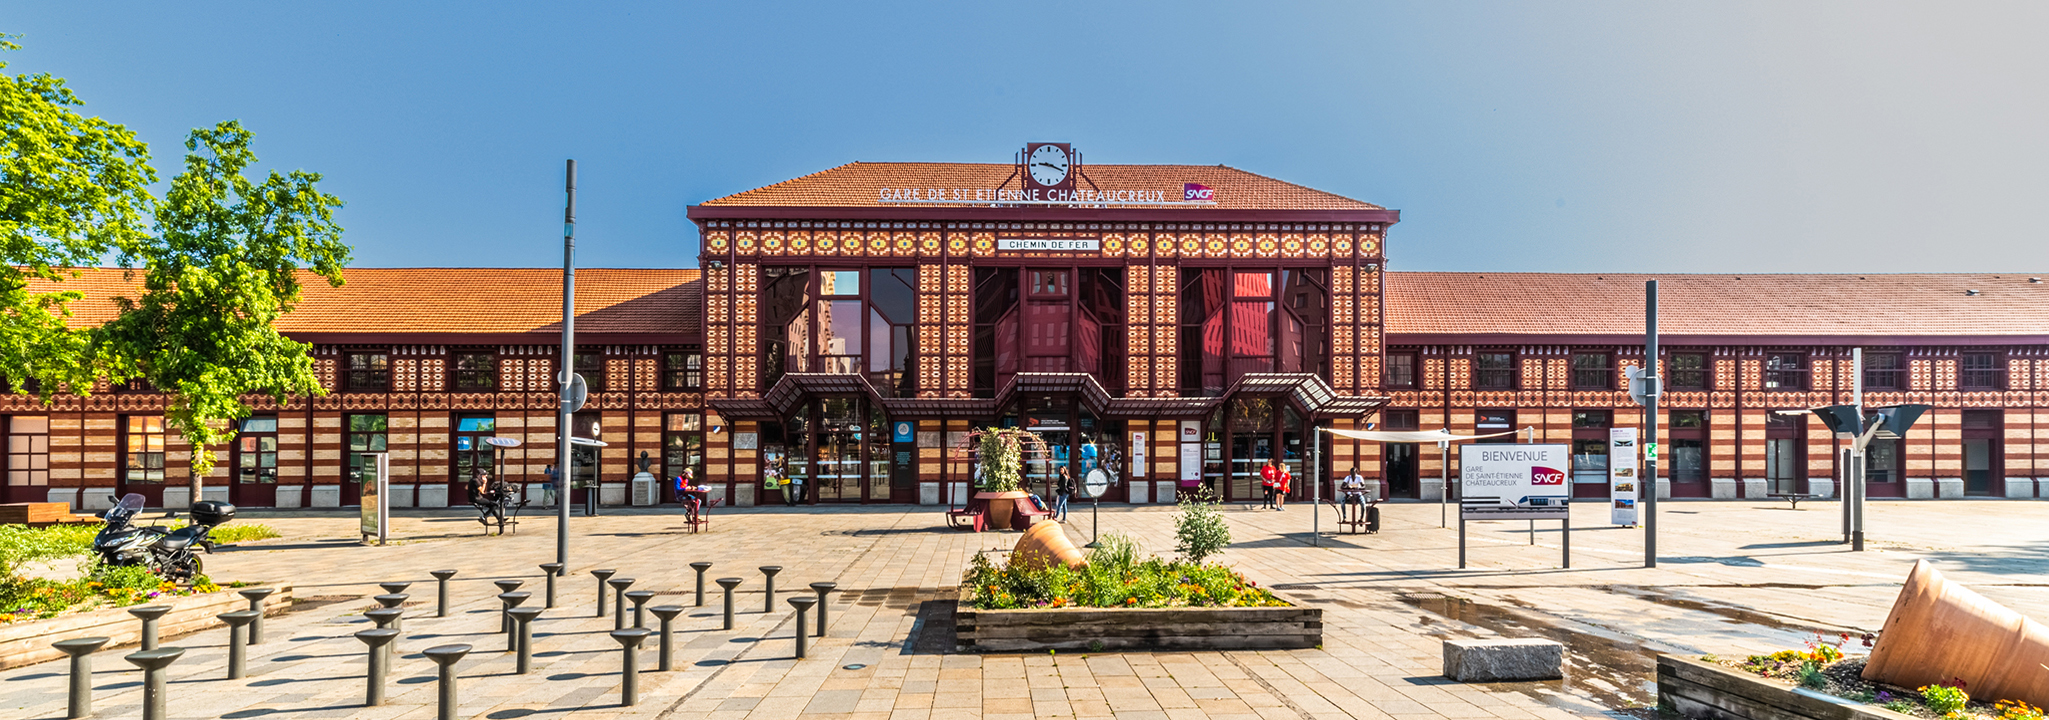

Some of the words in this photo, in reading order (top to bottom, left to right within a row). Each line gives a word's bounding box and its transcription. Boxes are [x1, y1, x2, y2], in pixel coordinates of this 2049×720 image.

[880, 188, 920, 200] GARE
[928, 188, 945, 200] DE
[953, 188, 969, 200] ST
[976, 188, 1040, 201] ETIENNE
[1047, 189, 1165, 202] CHATEAUCREUX
[1185, 189, 1214, 199] SNCF
[1009, 241, 1047, 249] CHEMIN
[1051, 241, 1064, 249] DE
[1069, 241, 1088, 249] FER
[1482, 451, 1548, 461] BIENVENUE
[1475, 472, 1523, 480] SAINT-ÉTIENNE
[1533, 473, 1563, 483] SNCF
